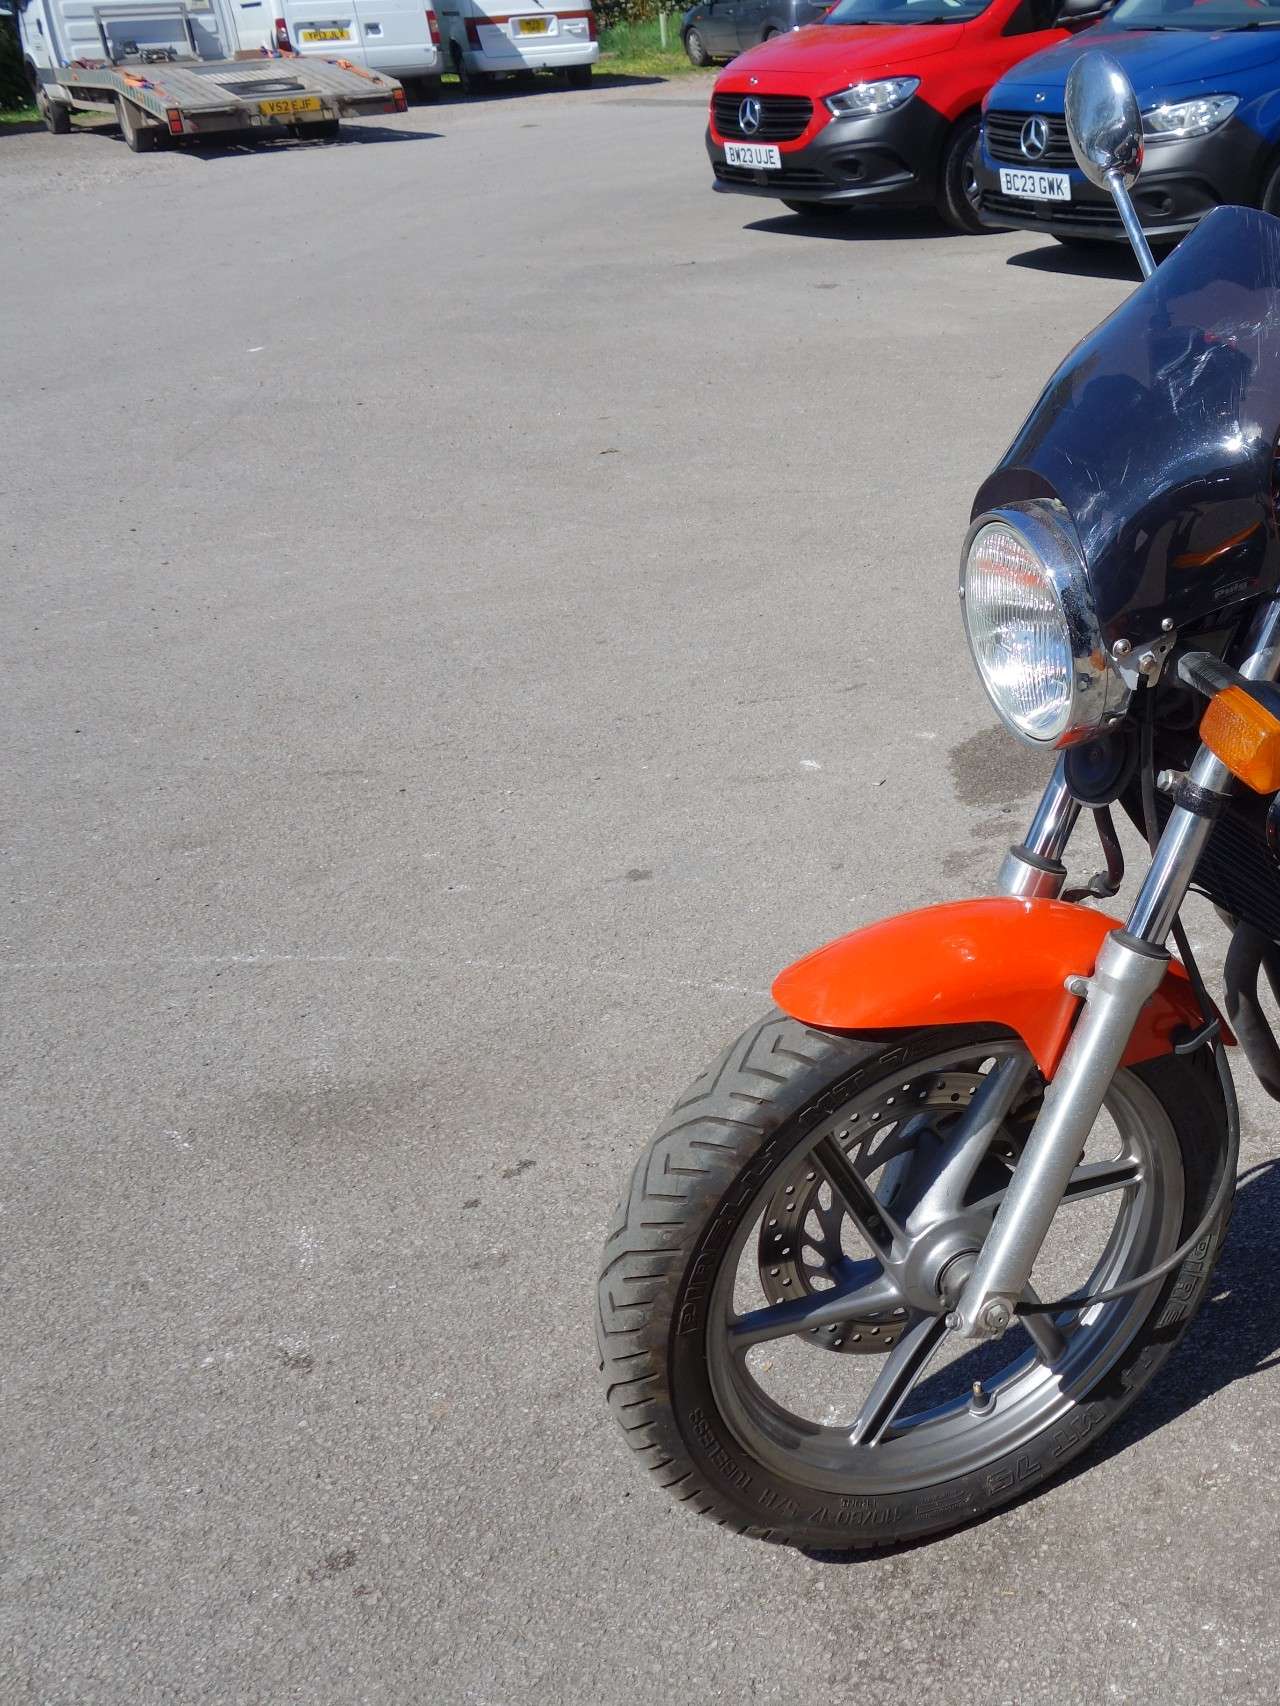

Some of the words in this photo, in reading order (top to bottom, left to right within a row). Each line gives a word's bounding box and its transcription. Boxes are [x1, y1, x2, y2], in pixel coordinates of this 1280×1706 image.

[728, 147, 754, 164] BW23
[755, 149, 776, 165] UJE
[1005, 173, 1036, 193] BC23
[1039, 176, 1065, 196] GWK
[1053, 1402, 1105, 1457] MT
[986, 1455, 1042, 1496] 75
